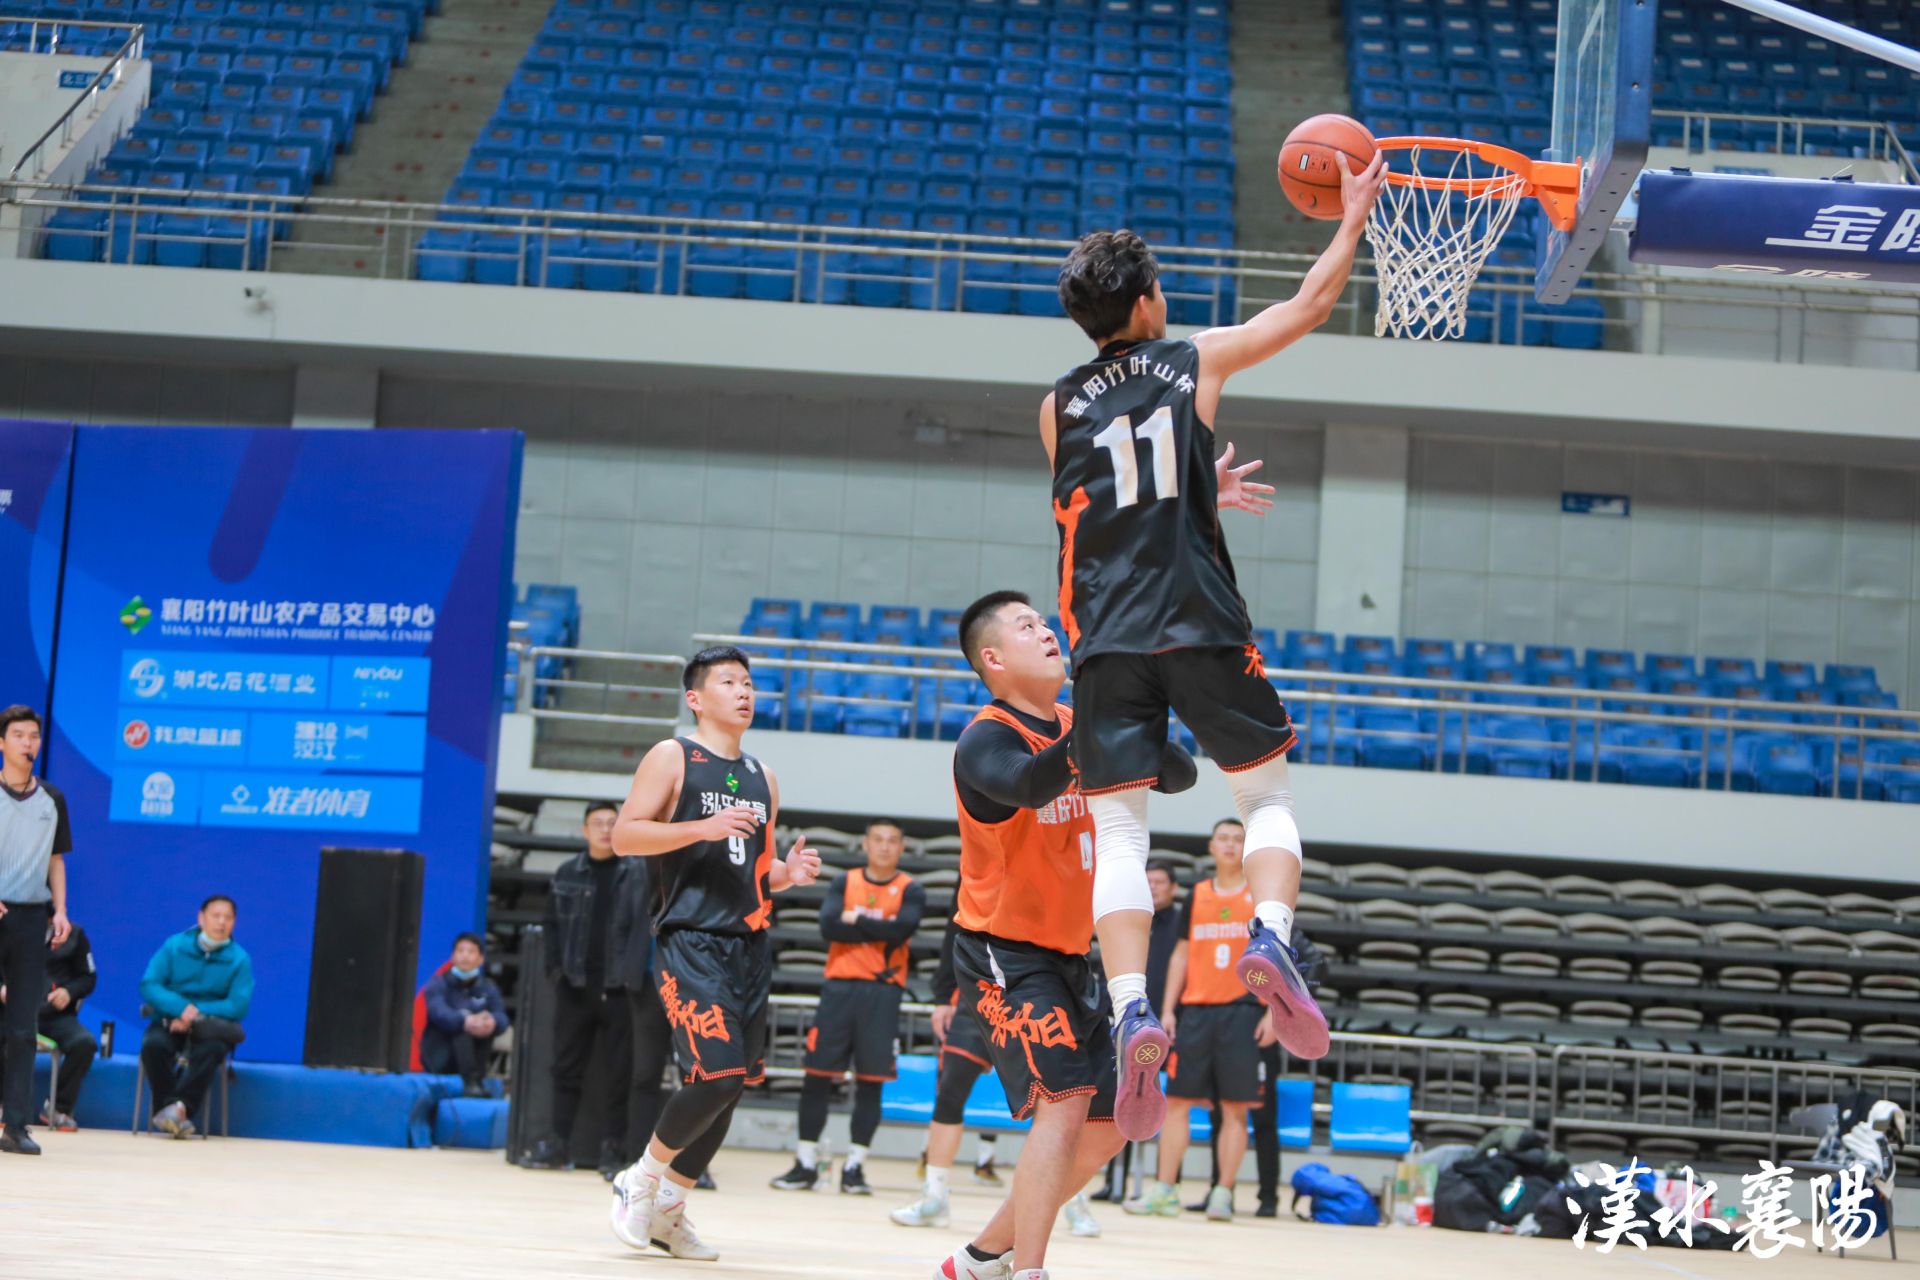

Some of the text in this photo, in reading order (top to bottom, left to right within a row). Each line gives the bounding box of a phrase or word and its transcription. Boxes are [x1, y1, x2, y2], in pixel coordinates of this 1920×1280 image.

[1092, 405, 1179, 510] 11
[160, 598, 436, 628] 襄阳竹叶山农产品交易中心
[261, 786, 372, 818] 准者体育
[728, 835, 746, 866] 9
